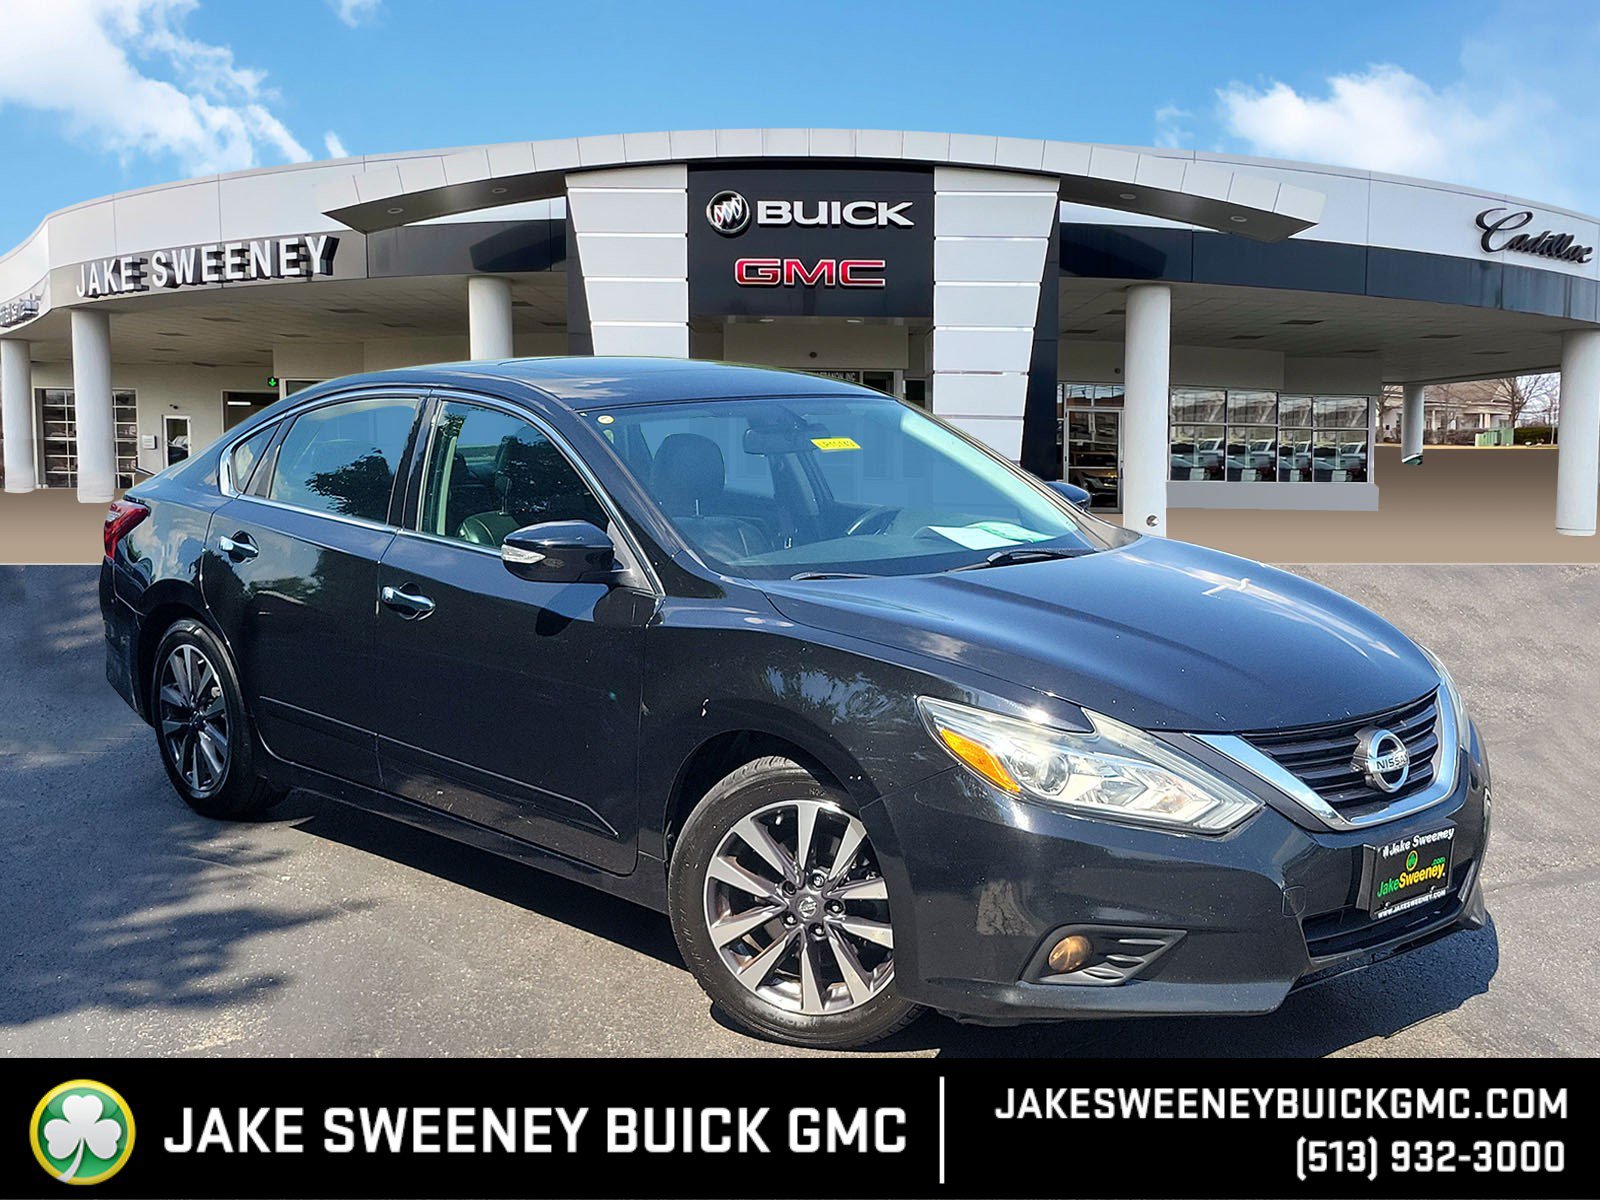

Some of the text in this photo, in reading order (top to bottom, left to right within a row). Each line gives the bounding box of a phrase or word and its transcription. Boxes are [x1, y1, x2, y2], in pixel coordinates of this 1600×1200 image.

[757, 200, 915, 226] BUICK
[1475, 207, 1593, 263] Cadillac
[76, 234, 330, 298] JAKE SWEENEY
[735, 258, 886, 287] GMC
[1389, 827, 1455, 857] Jake Sweeney
